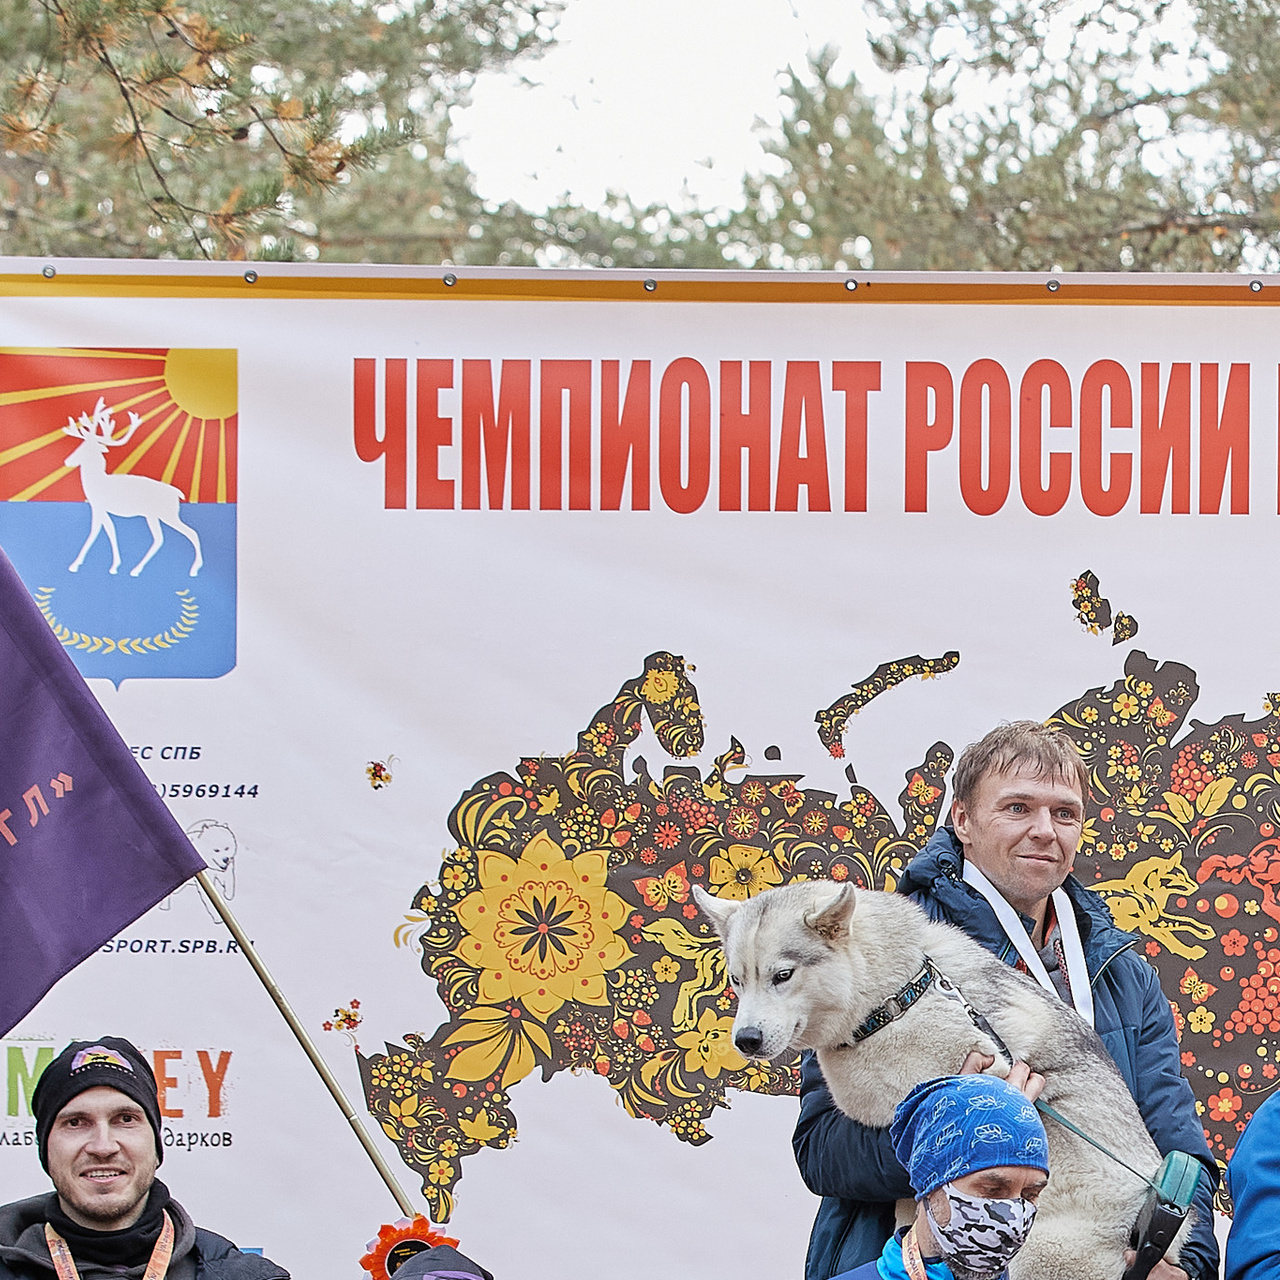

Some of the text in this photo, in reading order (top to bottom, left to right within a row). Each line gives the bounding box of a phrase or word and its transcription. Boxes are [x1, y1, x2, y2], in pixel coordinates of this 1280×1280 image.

[353, 356, 881, 514] ЧЕМПИОНАТ
[904, 358, 1250, 517] РОССИИ
[160, 746, 201, 760] СПБ
[153, 784, 259, 799] )5969144
[102, 940, 254, 954] SPORT.SPB.R
[163, 1129, 232, 1151] дарков
